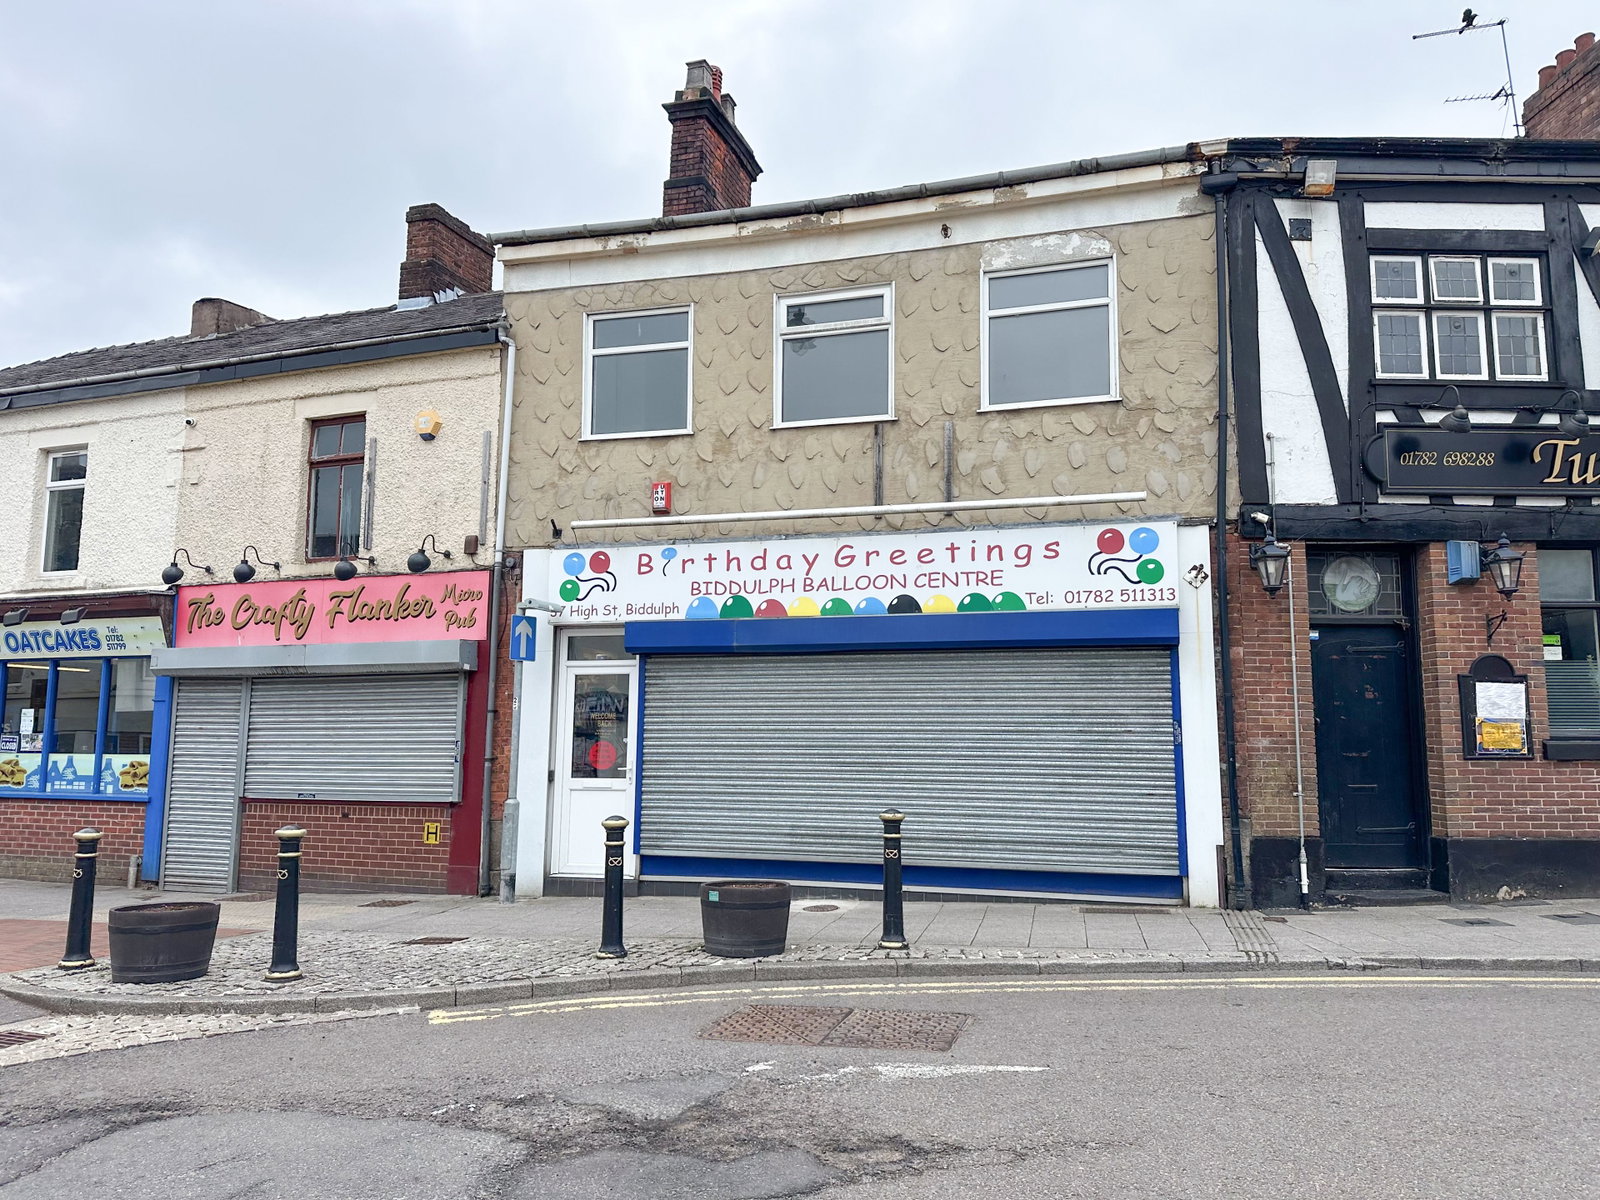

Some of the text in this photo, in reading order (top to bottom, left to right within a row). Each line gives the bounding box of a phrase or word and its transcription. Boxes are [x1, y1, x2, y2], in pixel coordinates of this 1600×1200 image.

[1400, 451, 1495, 467] 01782 698288
[834, 539, 1060, 568] Greetings
[690, 569, 1004, 596] BIDDULPH BALLOON CENTRE
[440, 583, 483, 605] Micro
[1025, 587, 1176, 605] Tel: 01782 511313
[187, 581, 437, 641] The Crafty Flanker
[444, 607, 478, 632] Pub
[570, 604, 598, 620] High
[602, 604, 622, 618] St,
[626, 602, 680, 618] Biddulph
[4, 627, 102, 654] OATCAKES
[105, 634, 124, 642] 01782
[107, 642, 127, 651] 511799
[426, 825, 438, 841] H
